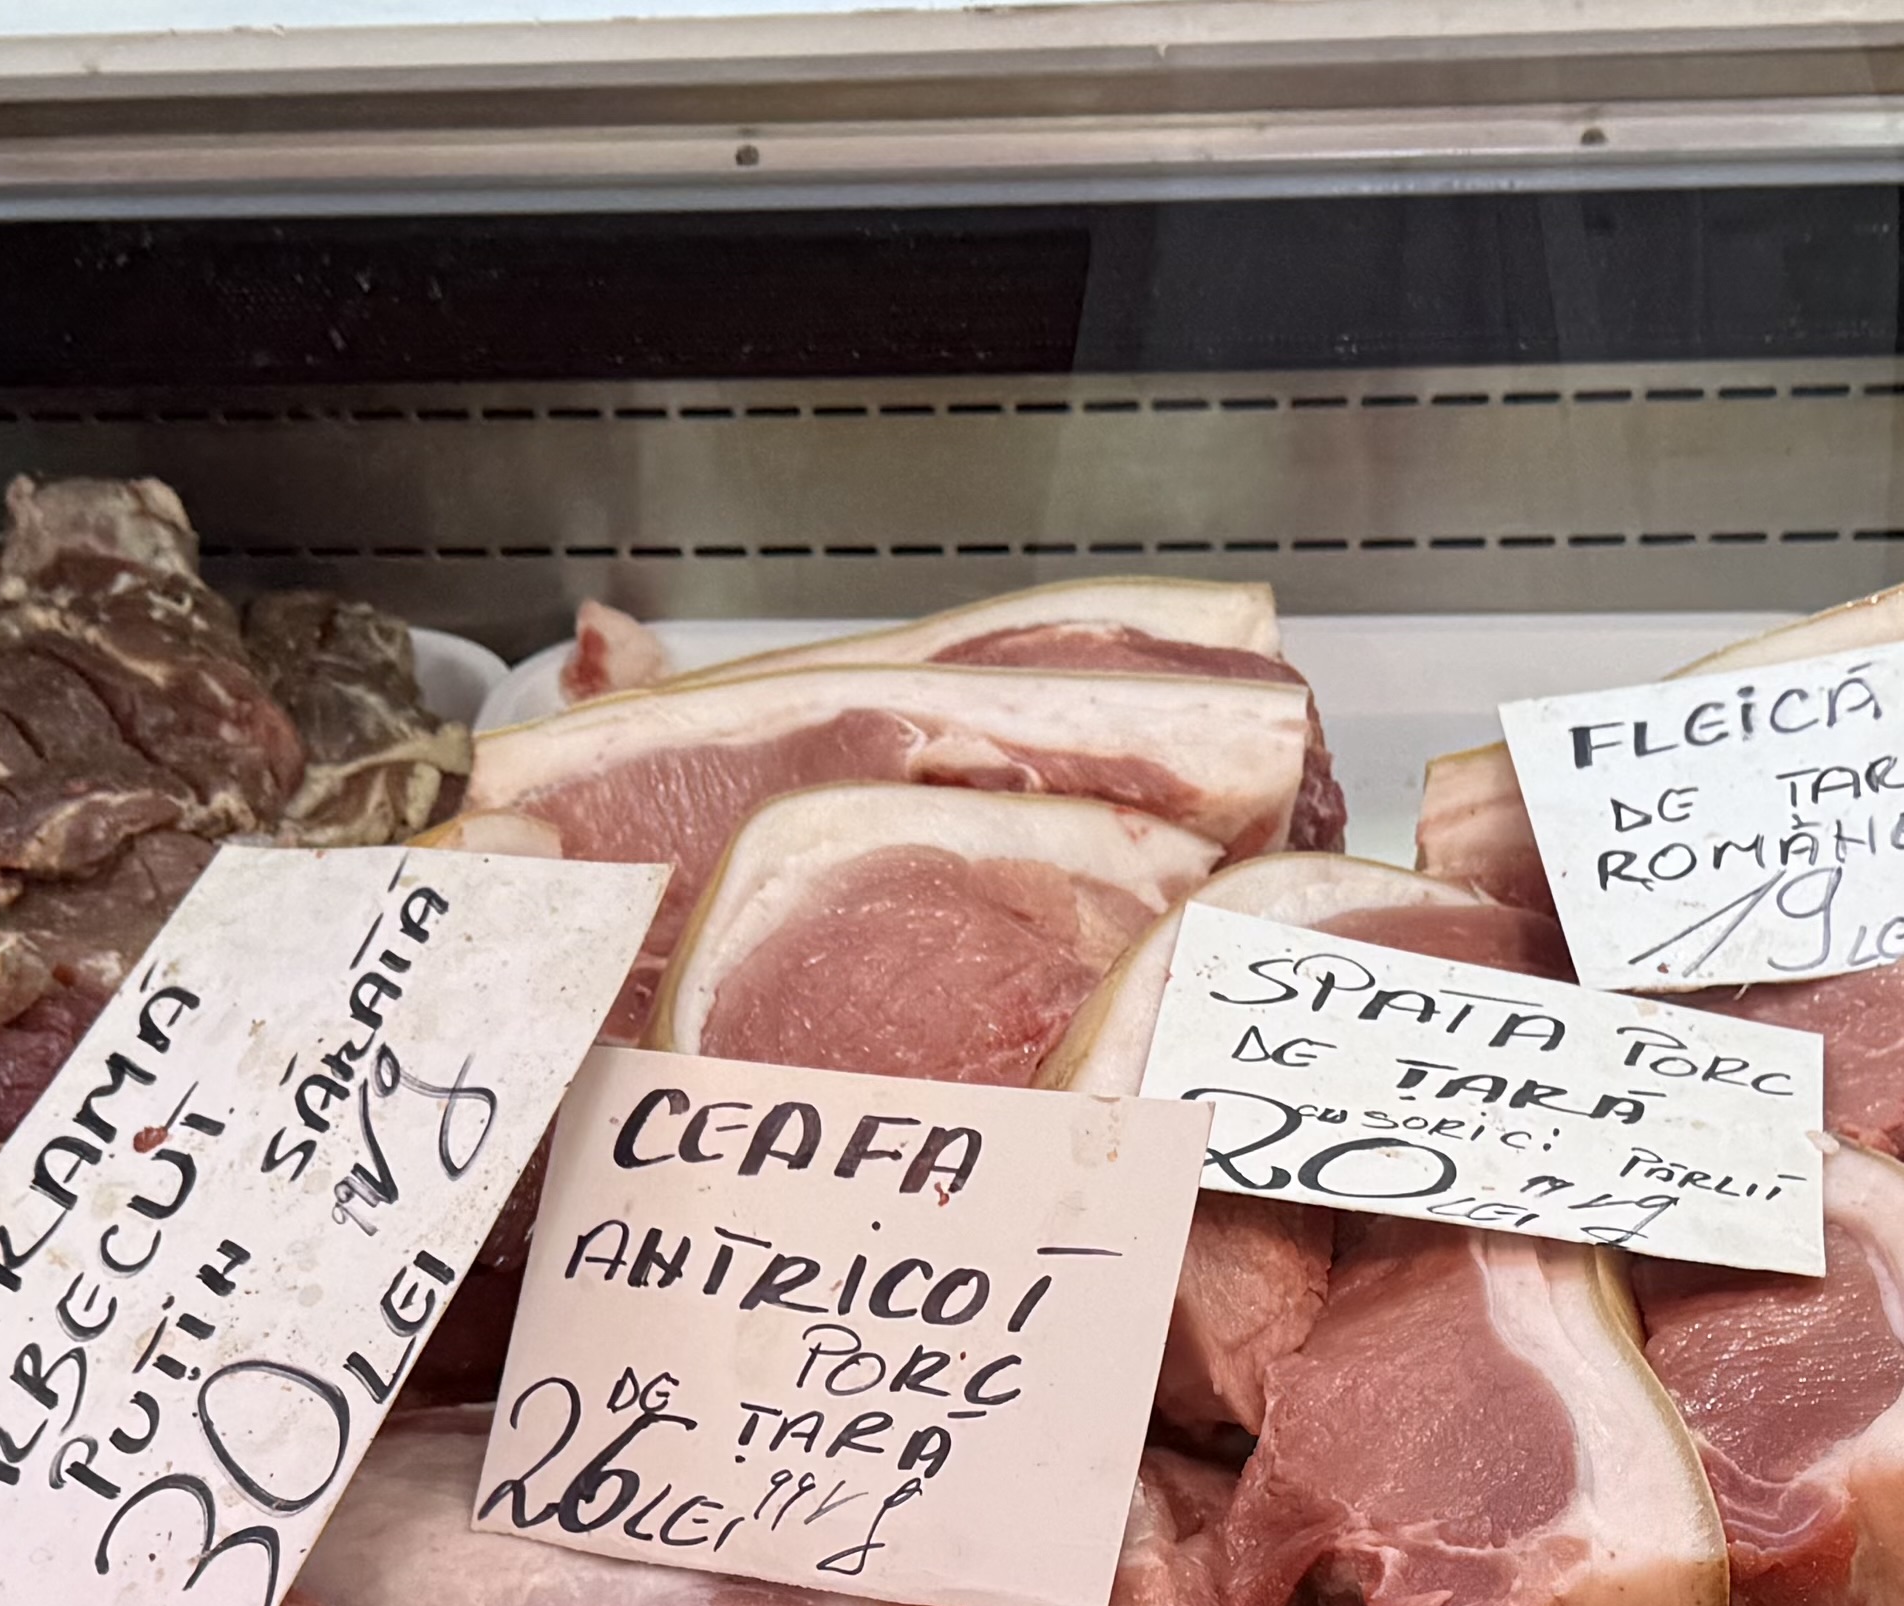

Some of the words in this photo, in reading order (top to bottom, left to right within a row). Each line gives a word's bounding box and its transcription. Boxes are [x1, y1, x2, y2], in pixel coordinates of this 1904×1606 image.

[1611, 787, 1699, 831] DE
[1232, 1026, 1337, 1067] DE
[1617, 1026, 1794, 1097] PORC
[613, 1089, 983, 1195] CEAFA
[1181, 1087, 1457, 1199] 20
[344, 1249, 456, 1404] LEI
[797, 1324, 1022, 1407] PORC
[607, 1367, 679, 1414] DE
[478, 1377, 698, 1533] 26
[623, 1484, 745, 1551] LEI
